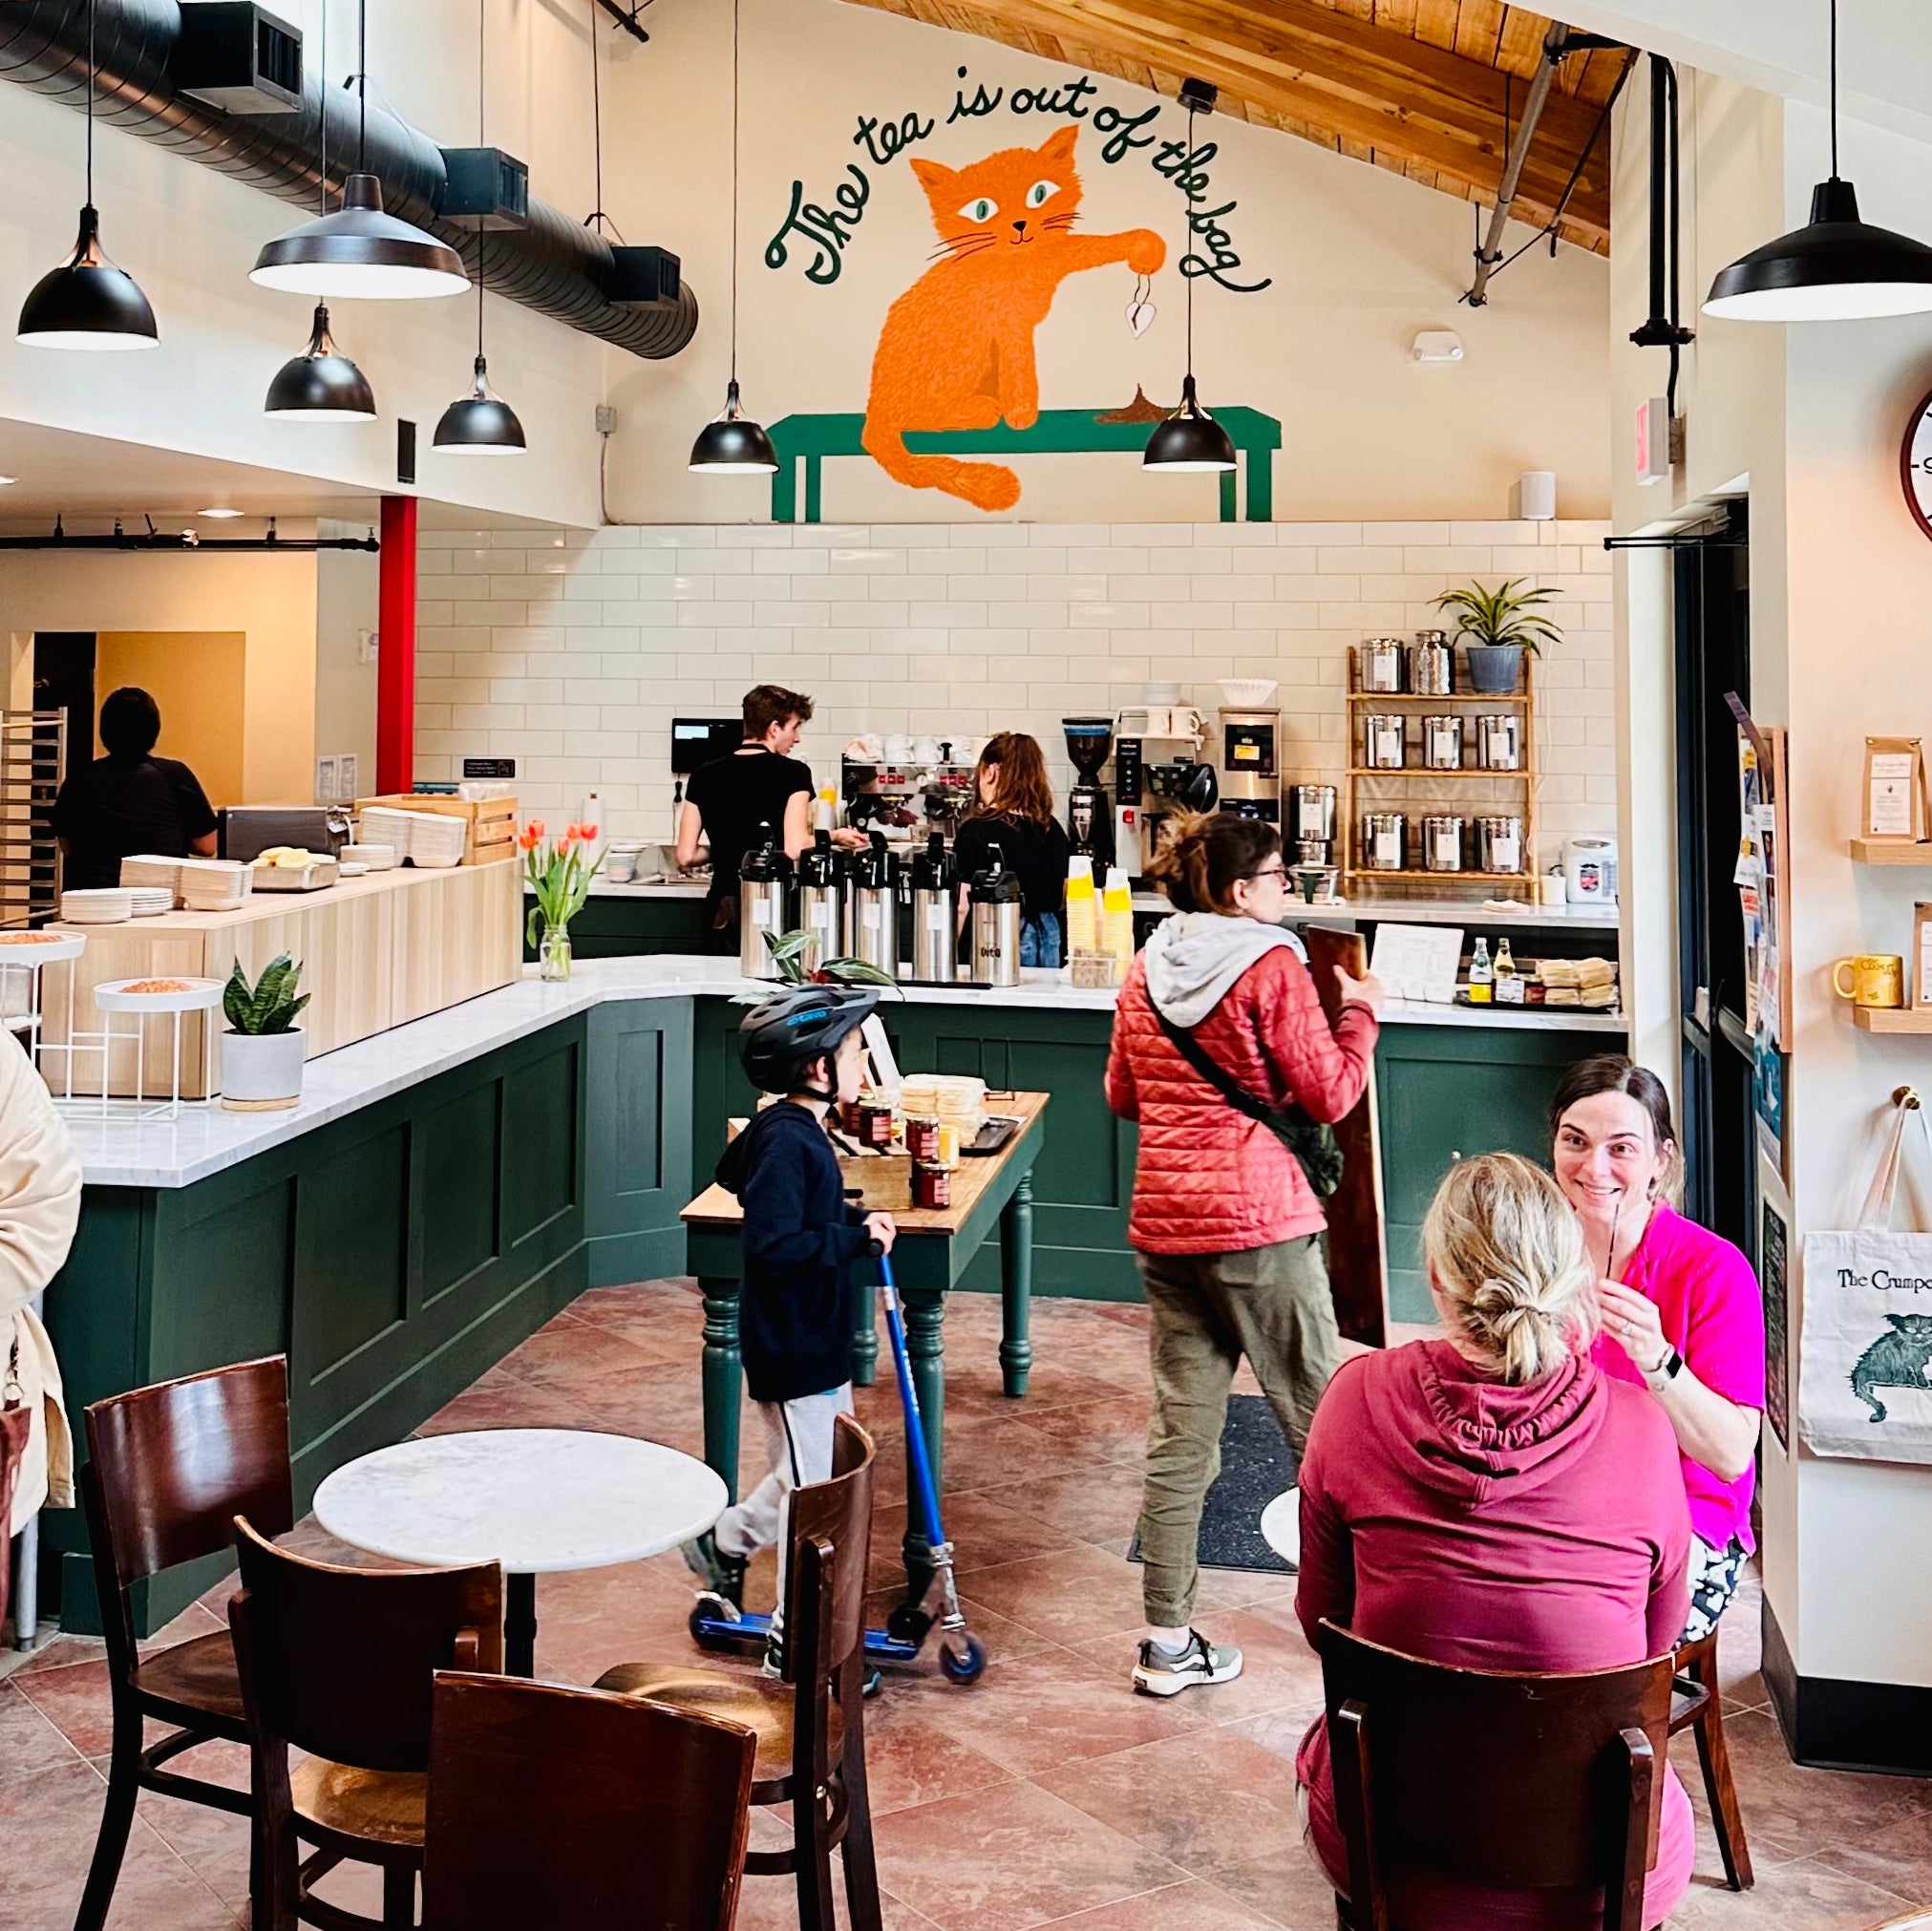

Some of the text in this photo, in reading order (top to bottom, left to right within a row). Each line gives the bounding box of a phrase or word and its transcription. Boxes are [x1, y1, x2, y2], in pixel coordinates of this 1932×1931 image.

[764, 66, 1273, 293] The tea is out of the bag
[1836, 1268, 1868, 1288] The
